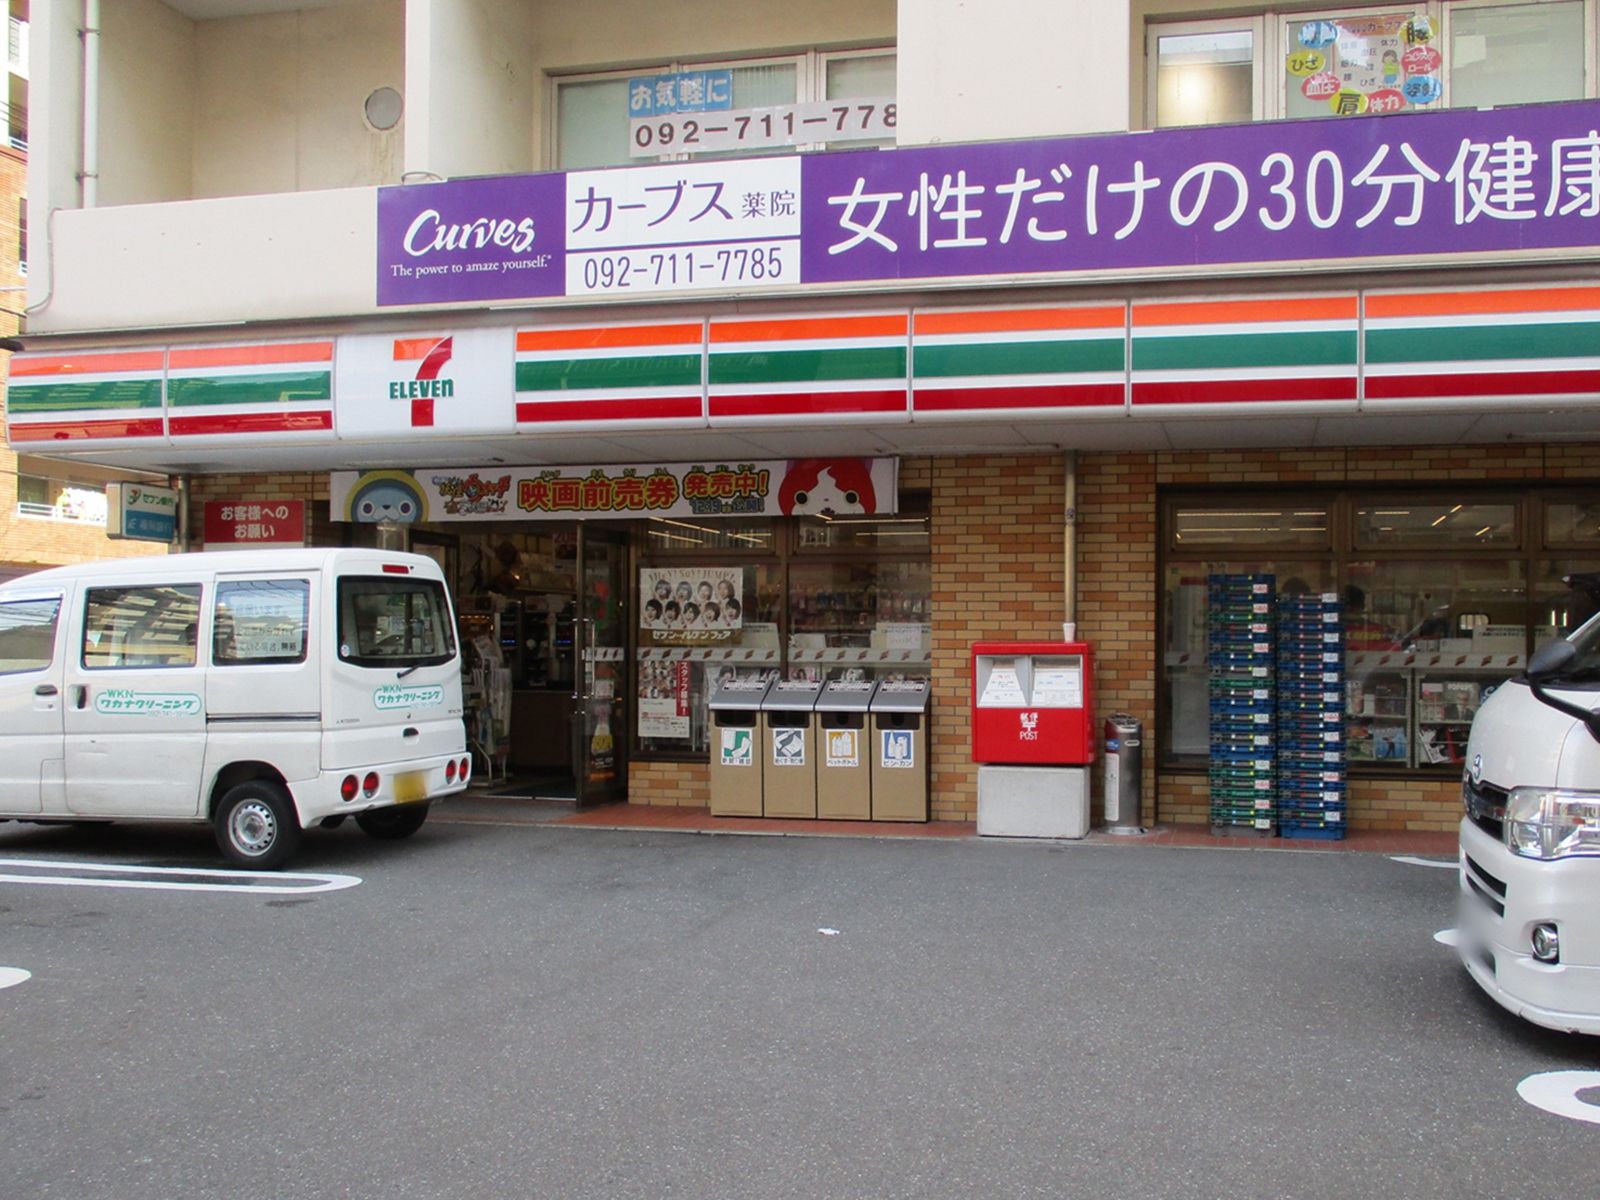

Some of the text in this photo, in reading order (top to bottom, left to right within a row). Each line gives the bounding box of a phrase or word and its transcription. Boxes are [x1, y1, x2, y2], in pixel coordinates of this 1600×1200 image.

[1292, 56, 1319, 72] ひざ
[631, 75, 729, 111] お気軽に
[1337, 92, 1361, 115] 肩
[1370, 94, 1400, 112] 体力
[827, 130, 1600, 256] 女性だけの30分健康
[572, 178, 796, 234] カーブス 薬院
[402, 208, 537, 257] Curves
[391, 264, 412, 277] The
[416, 263, 448, 279] power
[452, 263, 462, 272] to
[466, 261, 500, 272] amaze
[583, 247, 783, 290] 092-711-7785
[518, 474, 679, 512] 映画前売券
[685, 470, 770, 499] 発売中!
[220, 505, 289, 521] お客様への
[234, 524, 275, 538] お願い
[106, 689, 134, 698] WKN
[378, 690, 442, 704] ワカナクリーニング
[101, 700, 196, 710] ワカナクリーニング
[1020, 731, 1038, 740] POST
